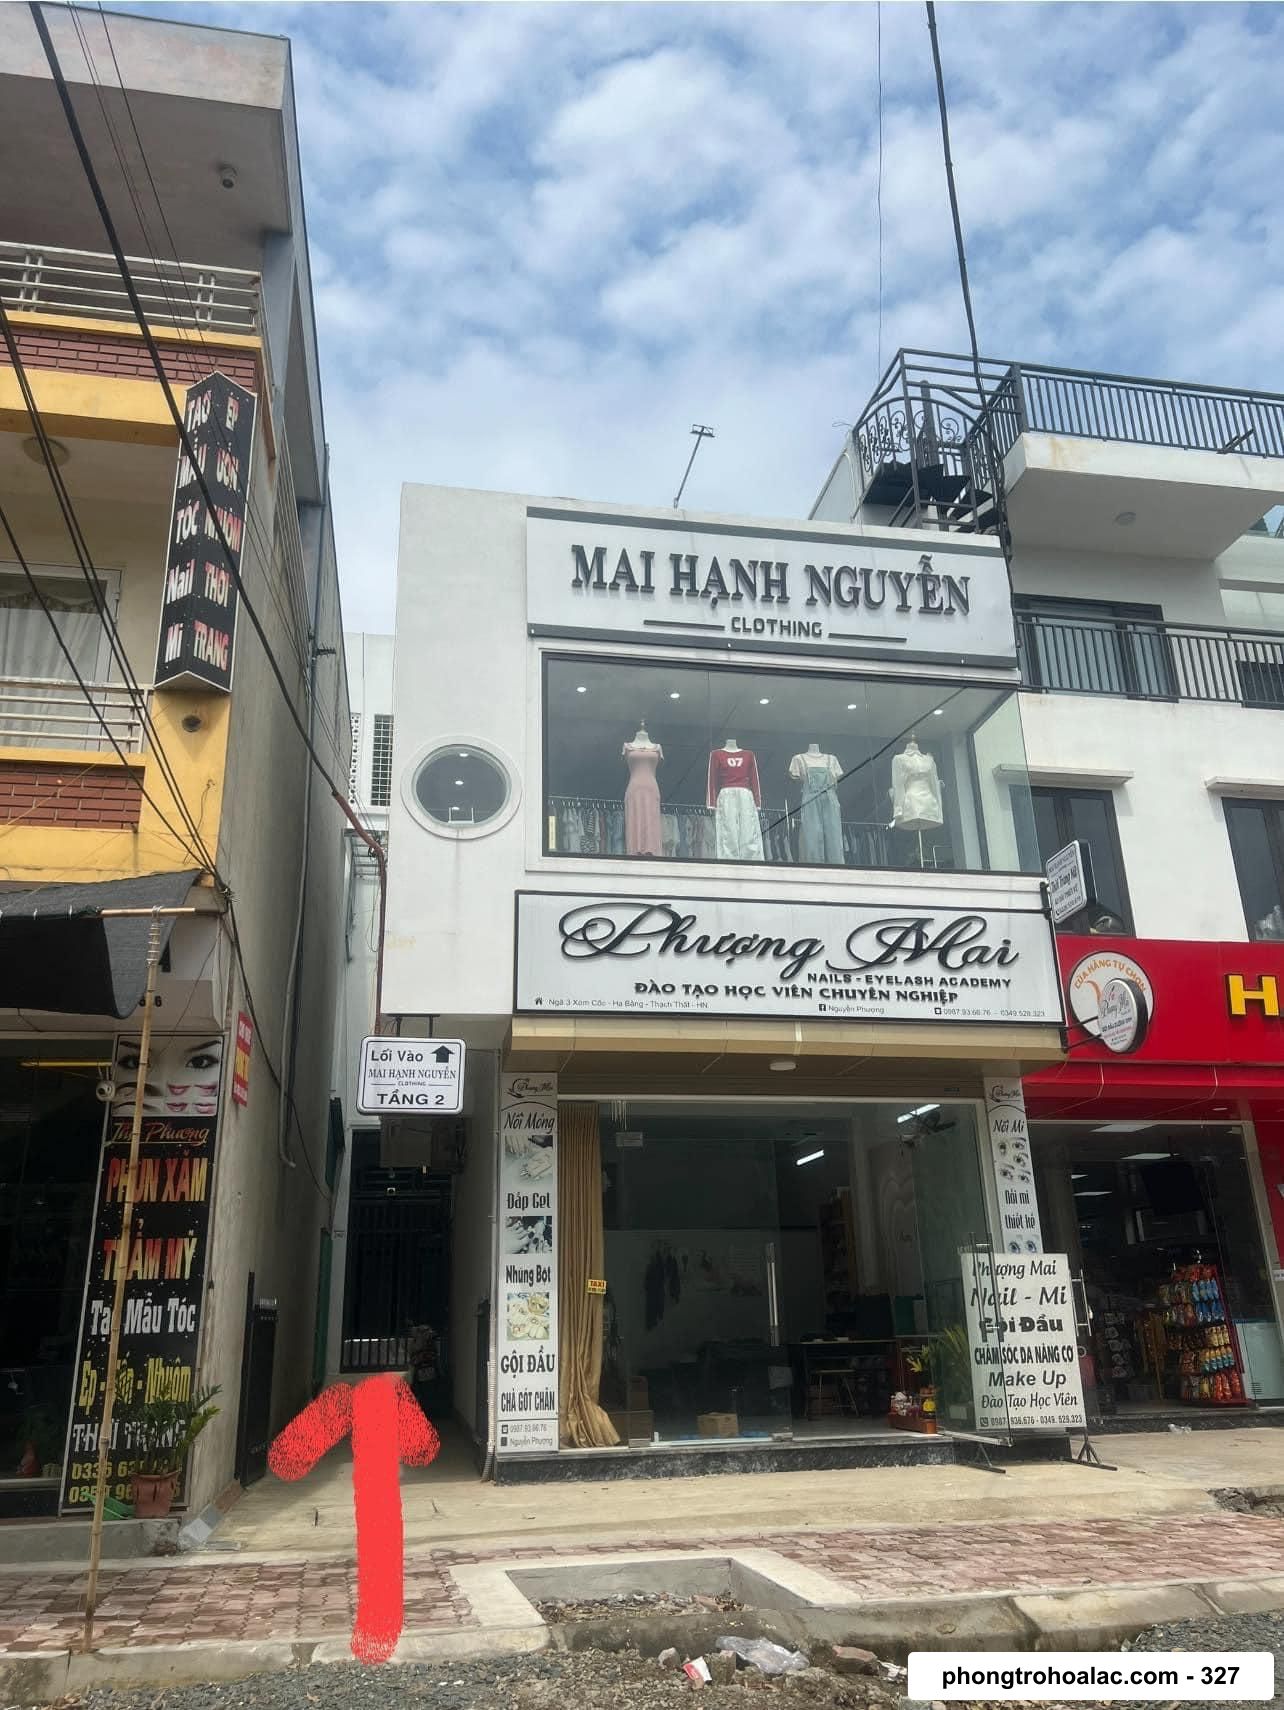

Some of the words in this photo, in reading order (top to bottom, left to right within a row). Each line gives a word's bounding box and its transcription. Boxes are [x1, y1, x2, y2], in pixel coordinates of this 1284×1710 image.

[166, 558, 196, 605] Nail
[571, 544, 655, 592] MAI
[669, 553, 790, 609] HẠNH
[805, 554, 971, 616] NGUYỄN
[731, 616, 823, 639] CLOTHING
[193, 620, 230, 671] TRANG
[727, 757, 743, 768] 07
[558, 901, 825, 980] Phượng
[826, 914, 1020, 973] Mai
[807, 973, 852, 984] NAILS
[865, 974, 934, 986] EYELASH
[940, 977, 1011, 988] ACADEMY
[634, 979, 676, 994] ĐÀO
[682, 984, 719, 999] TẠO
[725, 985, 766, 1000] HỌC
[772, 984, 813, 998] VIÊN
[819, 985, 894, 1000] CHUYÊN
[896, 988, 958, 1004] NGHIỆP
[371, 1048, 392, 1062] Lối
[397, 1049, 424, 1062] Vào
[368, 1068, 387, 1078] MAI
[389, 1068, 415, 1080] HẠNH
[418, 1065, 456, 1079] NGUYỄN
[376, 1088, 429, 1105] TẦNG
[435, 1094, 445, 1105] 2
[532, 1192, 551, 1209] Gel
[1030, 1259, 1057, 1276] Mai
[970, 1287, 1018, 1306] Nail
[1039, 1285, 1067, 1305] Mi
[90, 1300, 112, 1342] Tạ
[167, 1296, 196, 1333] Tóc
[1018, 1314, 1063, 1333] Đầu
[500, 1350, 524, 1379] GỘI
[527, 1345, 556, 1374] ĐẦU
[1020, 1347, 1034, 1364] DA
[989, 1371, 1036, 1387] Make
[1043, 1370, 1067, 1389] Up
[982, 1393, 1003, 1409] Đào
[1008, 1393, 1027, 1412] Tạo
[1030, 1391, 1050, 1413] Học
[1053, 1391, 1078, 1407] Viên
[73, 1419, 120, 1452] THI
